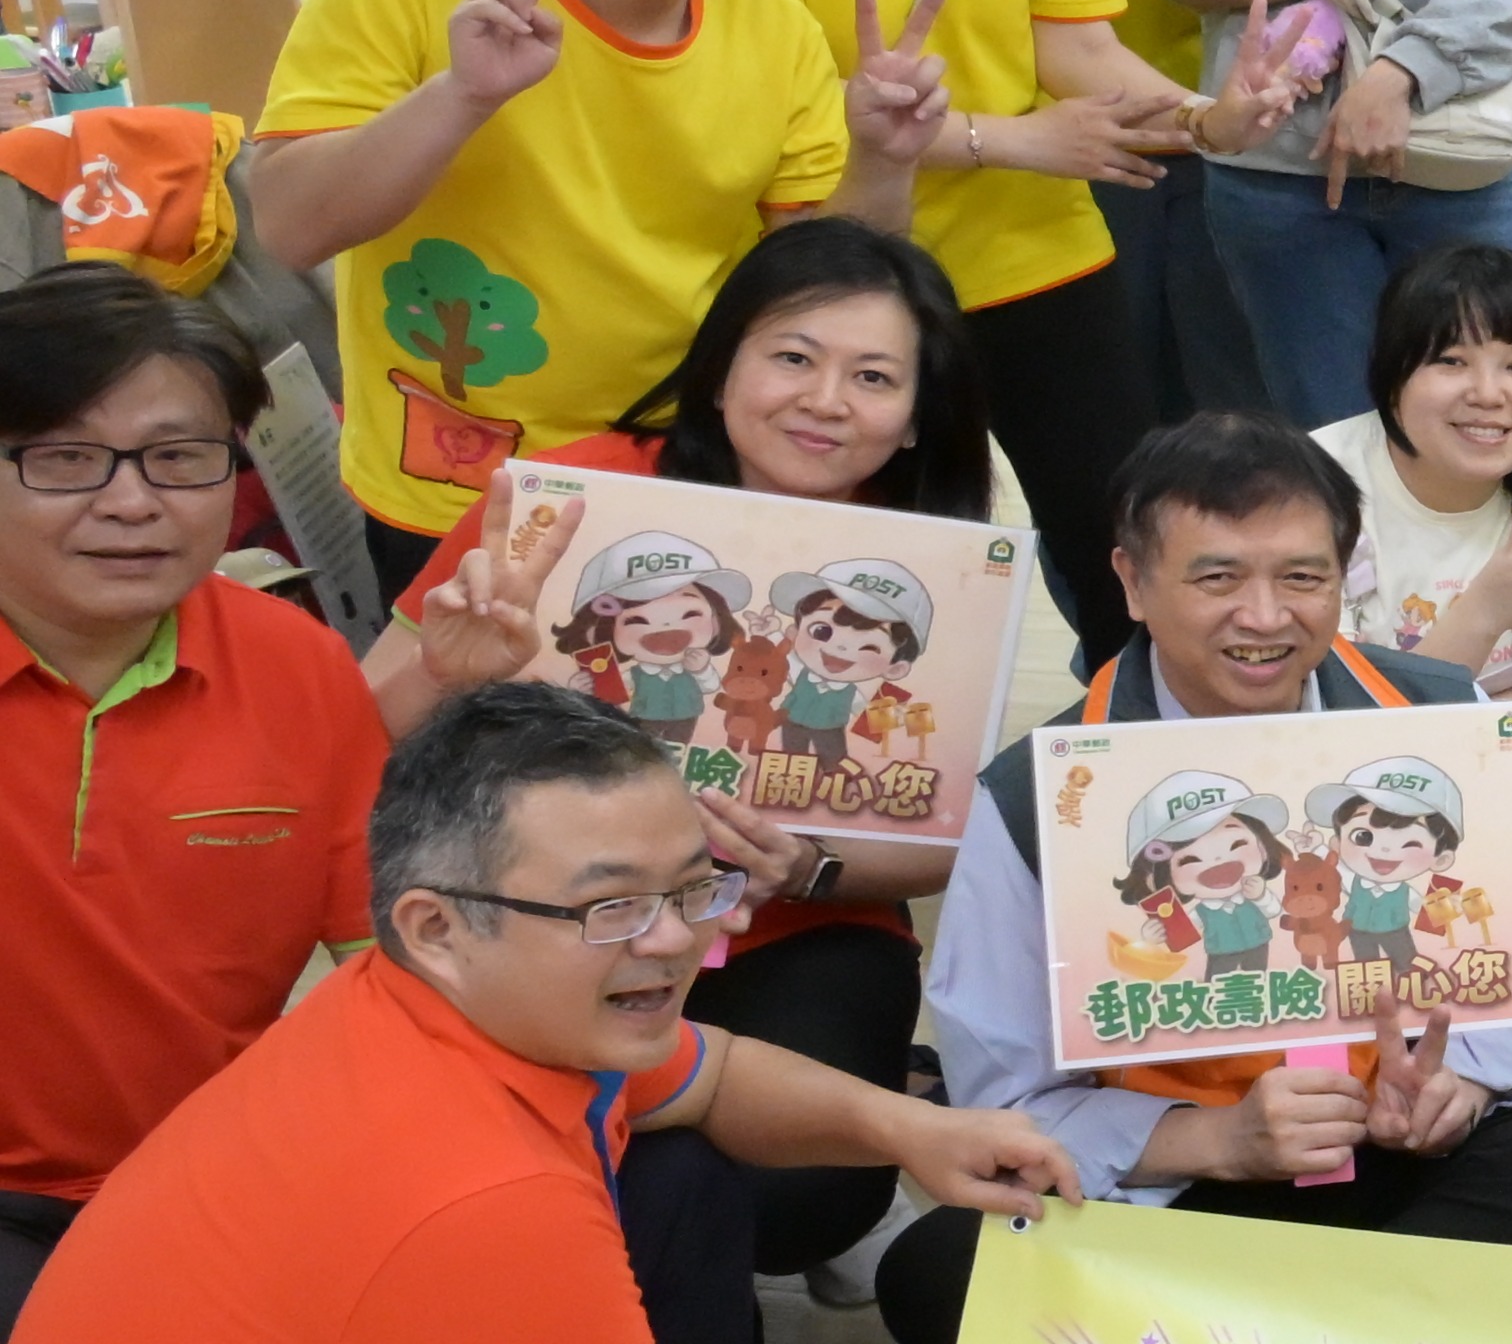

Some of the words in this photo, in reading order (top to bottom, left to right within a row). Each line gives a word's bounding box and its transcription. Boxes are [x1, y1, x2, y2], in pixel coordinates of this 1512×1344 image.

[626, 552, 693, 578] POST
[848, 573, 908, 601] POST
[754, 753, 938, 820] 關心您
[1376, 772, 1432, 794] POST
[1166, 788, 1227, 820] POST
[1088, 970, 1325, 1041] 郵政壽險
[1336, 949, 1509, 1020] 關心您
